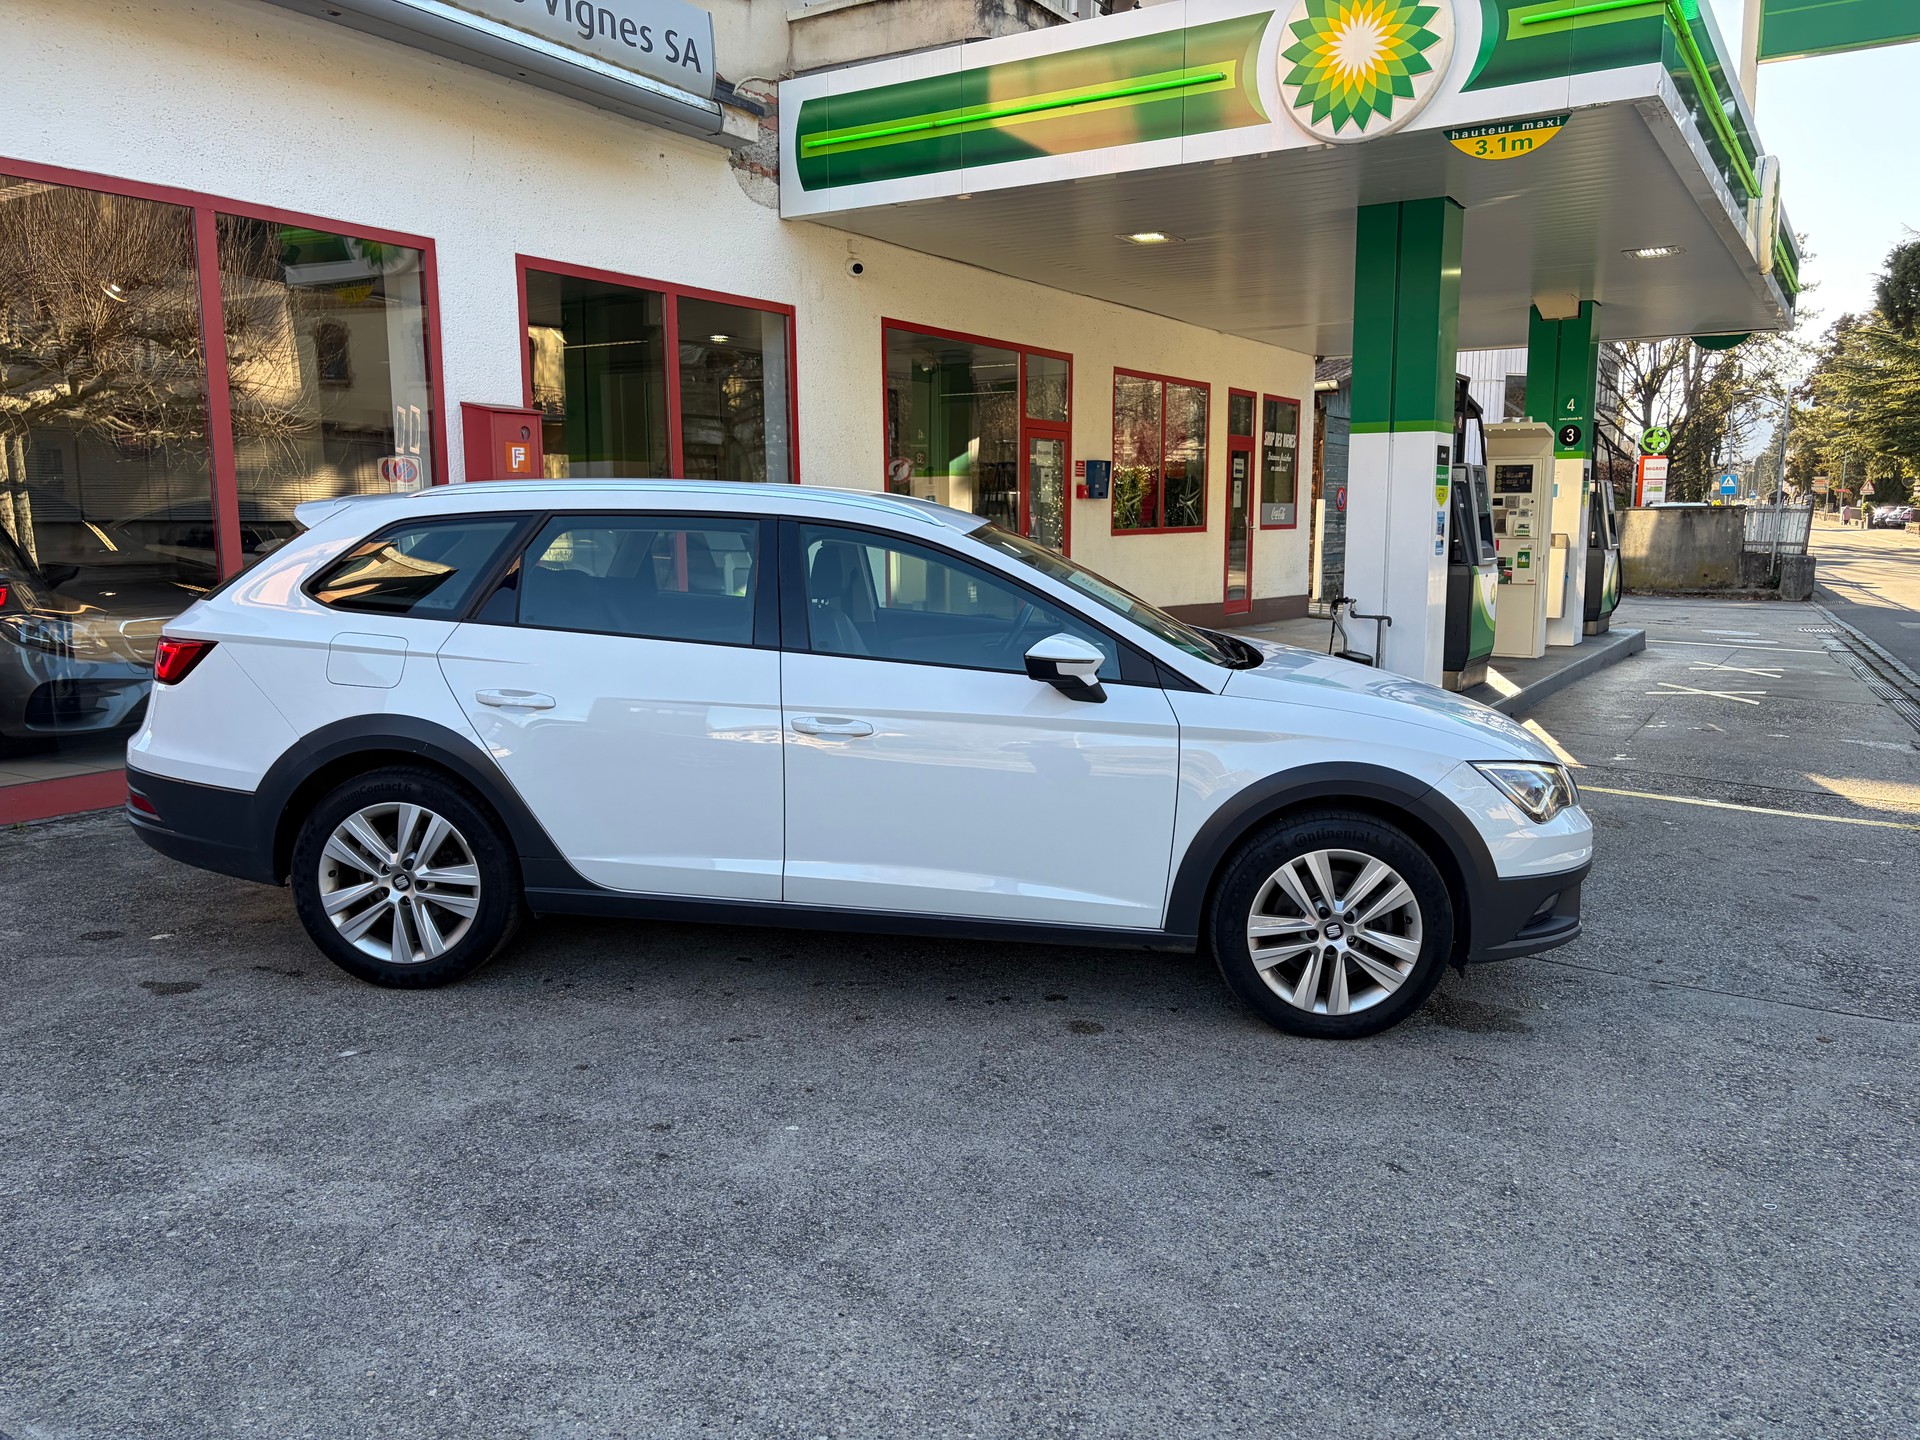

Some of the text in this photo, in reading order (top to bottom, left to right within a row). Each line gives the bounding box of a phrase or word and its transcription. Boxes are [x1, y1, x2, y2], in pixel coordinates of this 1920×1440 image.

[664, 29, 702, 73] SA
[1452, 116, 1561, 140] hauteur maxi
[1474, 136, 1533, 156] 3.1m
[1567, 398, 1575, 411] 4
[1566, 428, 1575, 442] 3
[512, 447, 525, 468] F
[331, 782, 402, 810] miumContact
[1293, 827, 1371, 848] Continental
